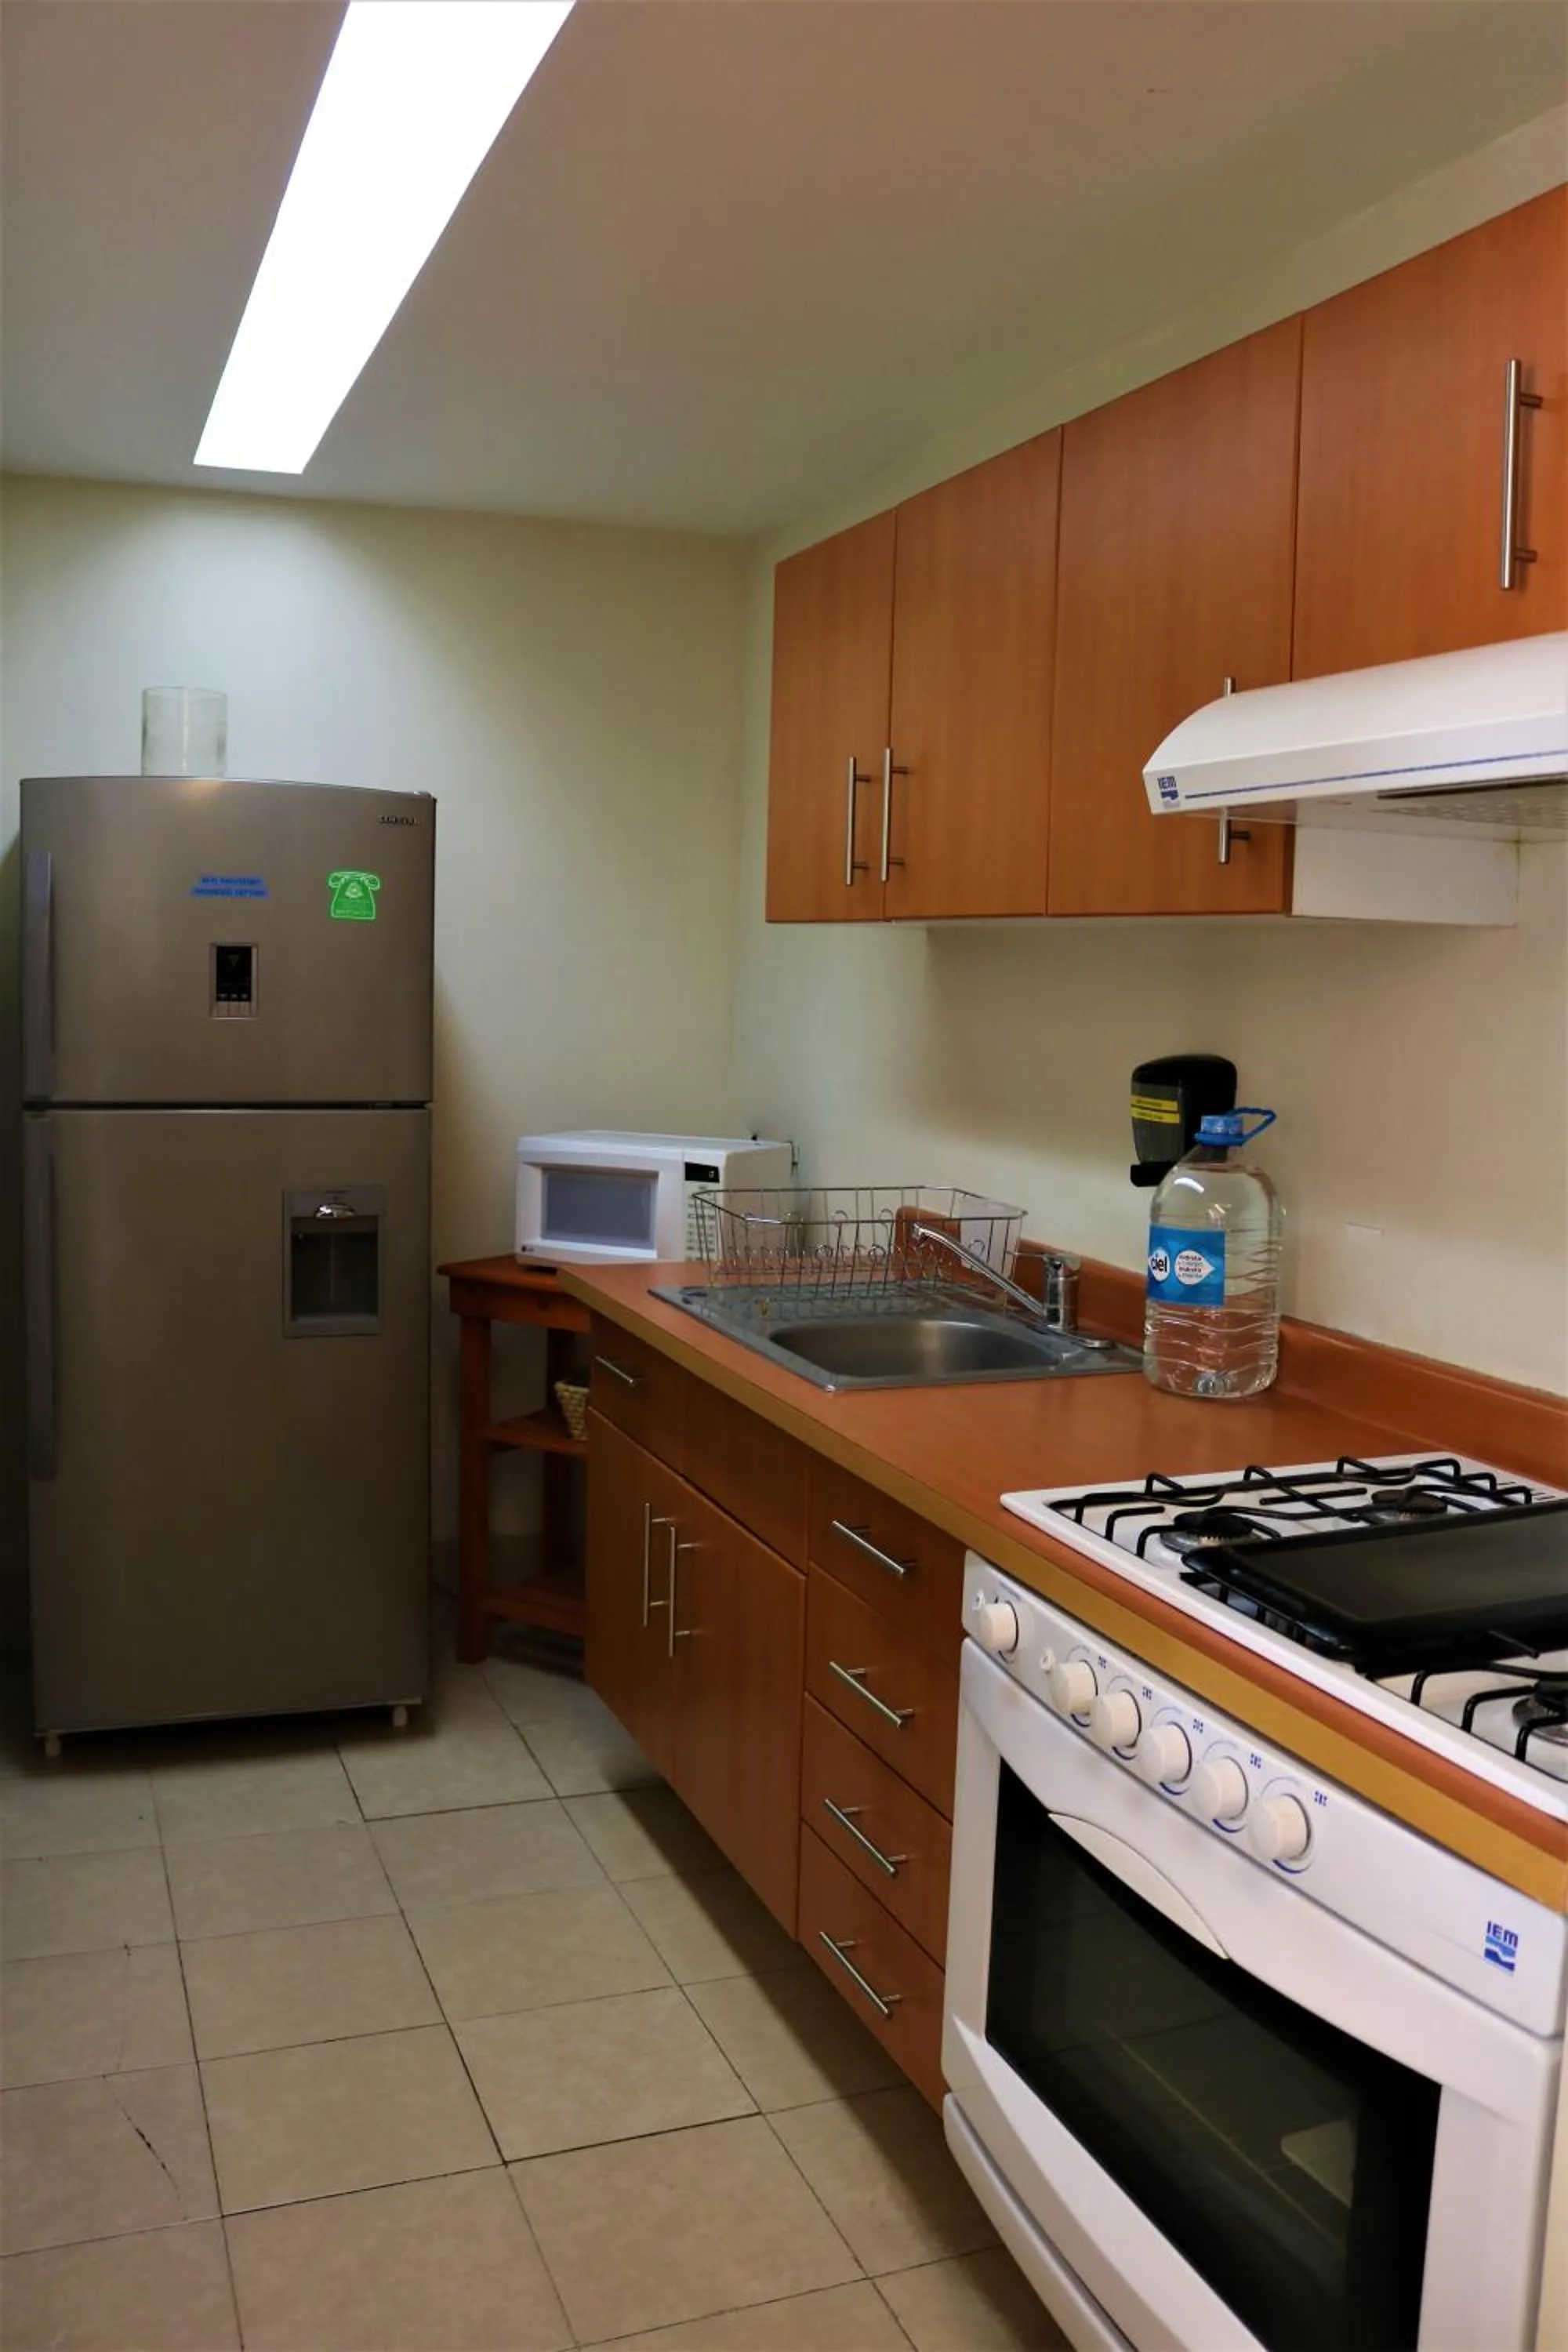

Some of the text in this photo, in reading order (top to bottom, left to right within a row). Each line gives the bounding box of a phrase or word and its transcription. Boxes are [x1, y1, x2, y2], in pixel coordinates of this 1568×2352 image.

[1157, 776, 1177, 789] IEM
[1151, 1254, 1167, 1272] ciel
[1486, 1920, 1519, 1947] IEM
